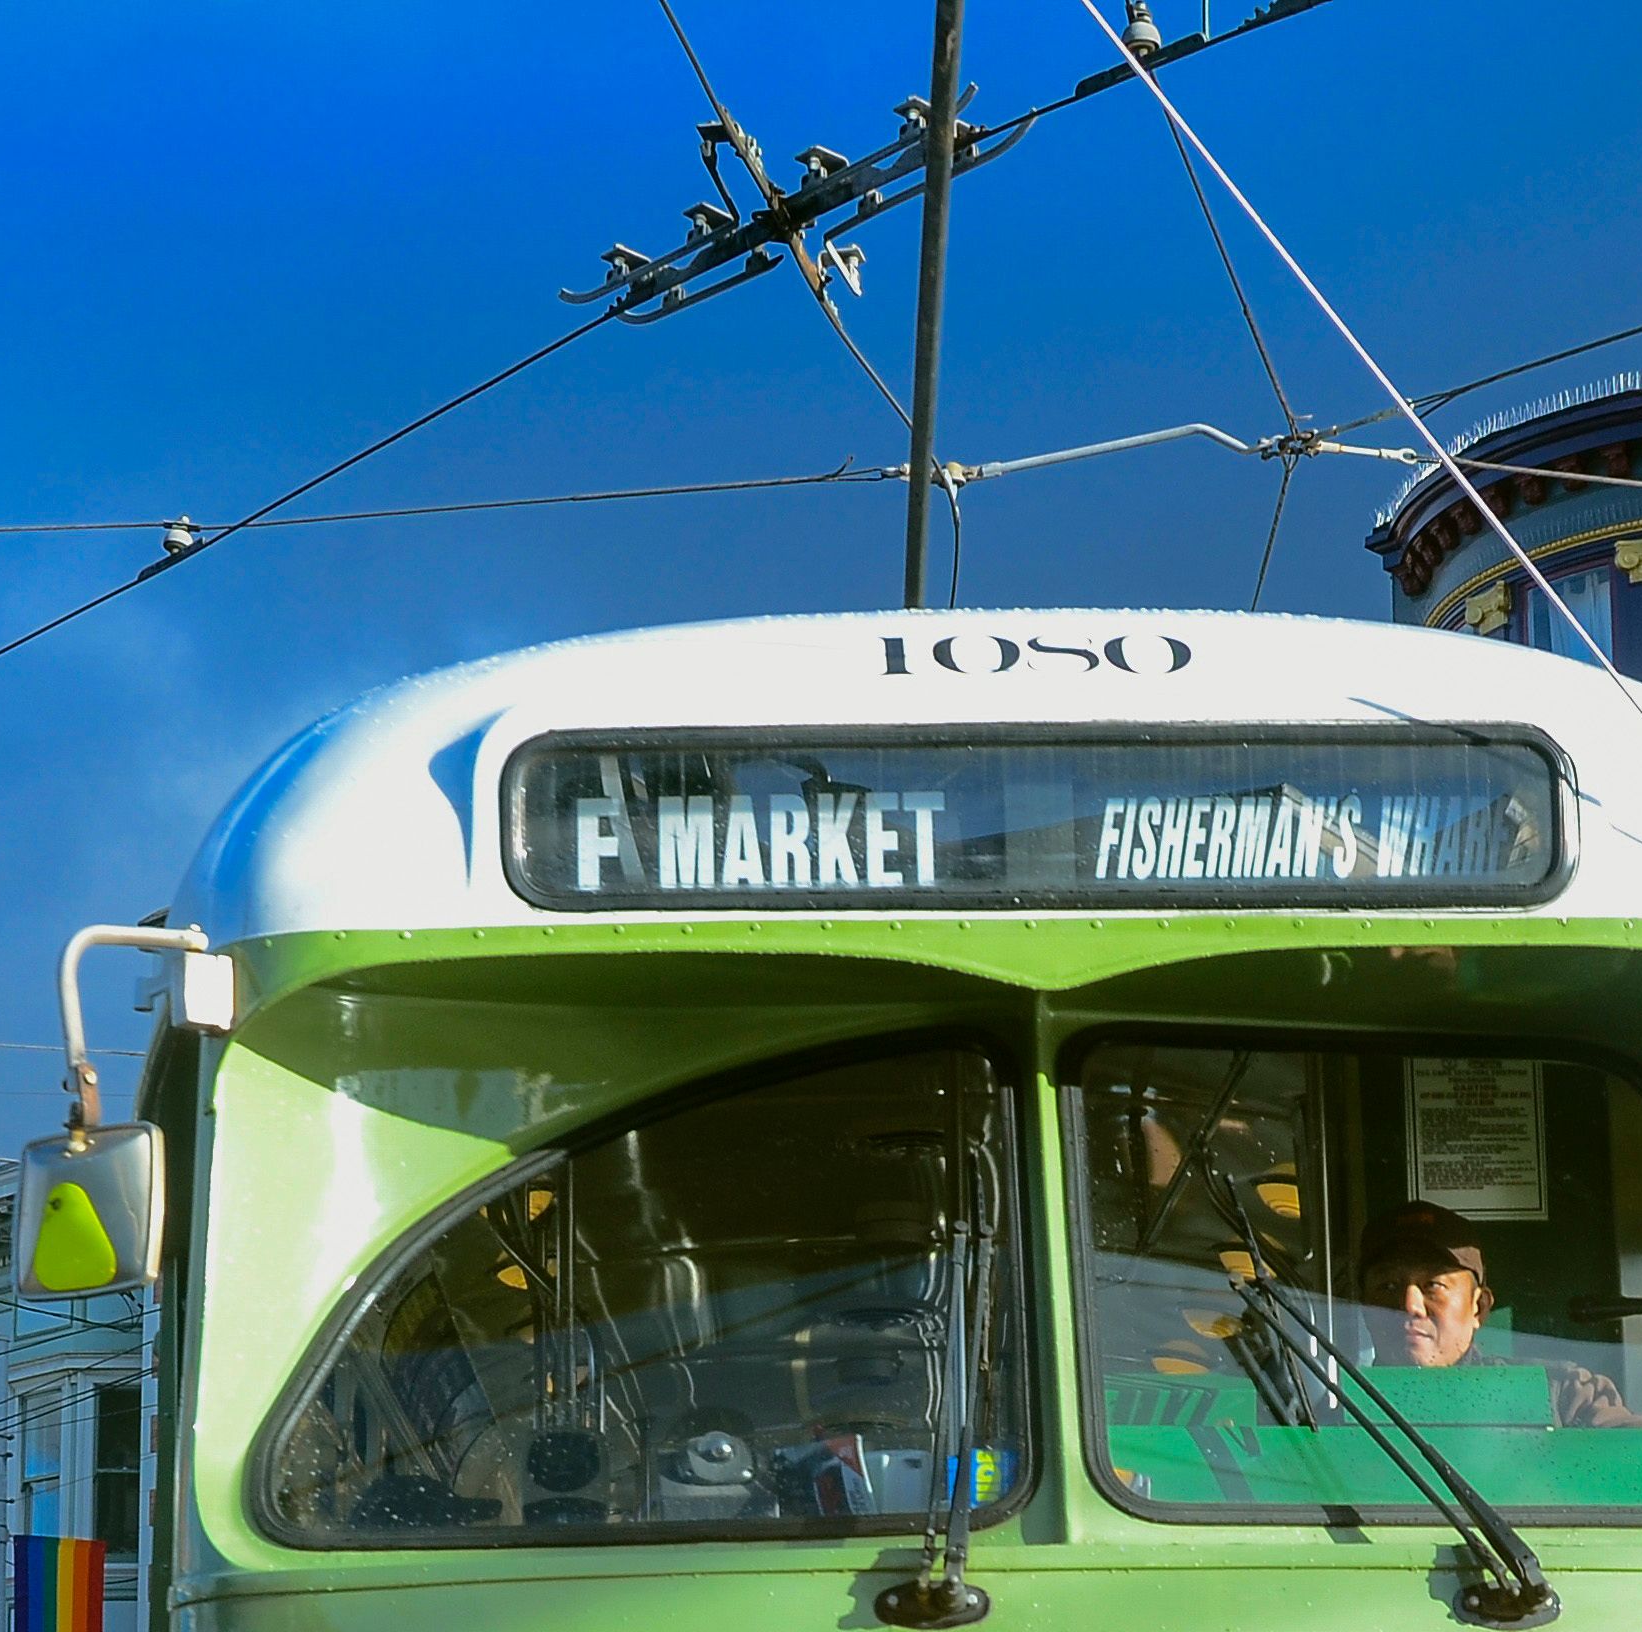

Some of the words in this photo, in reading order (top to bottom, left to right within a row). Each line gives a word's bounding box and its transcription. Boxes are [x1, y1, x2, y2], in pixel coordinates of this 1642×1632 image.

[878, 635, 1192, 676] 1080
[576, 797, 620, 891] F
[658, 791, 945, 889] MARKET
[1095, 794, 1361, 880] FISHERMAN'S
